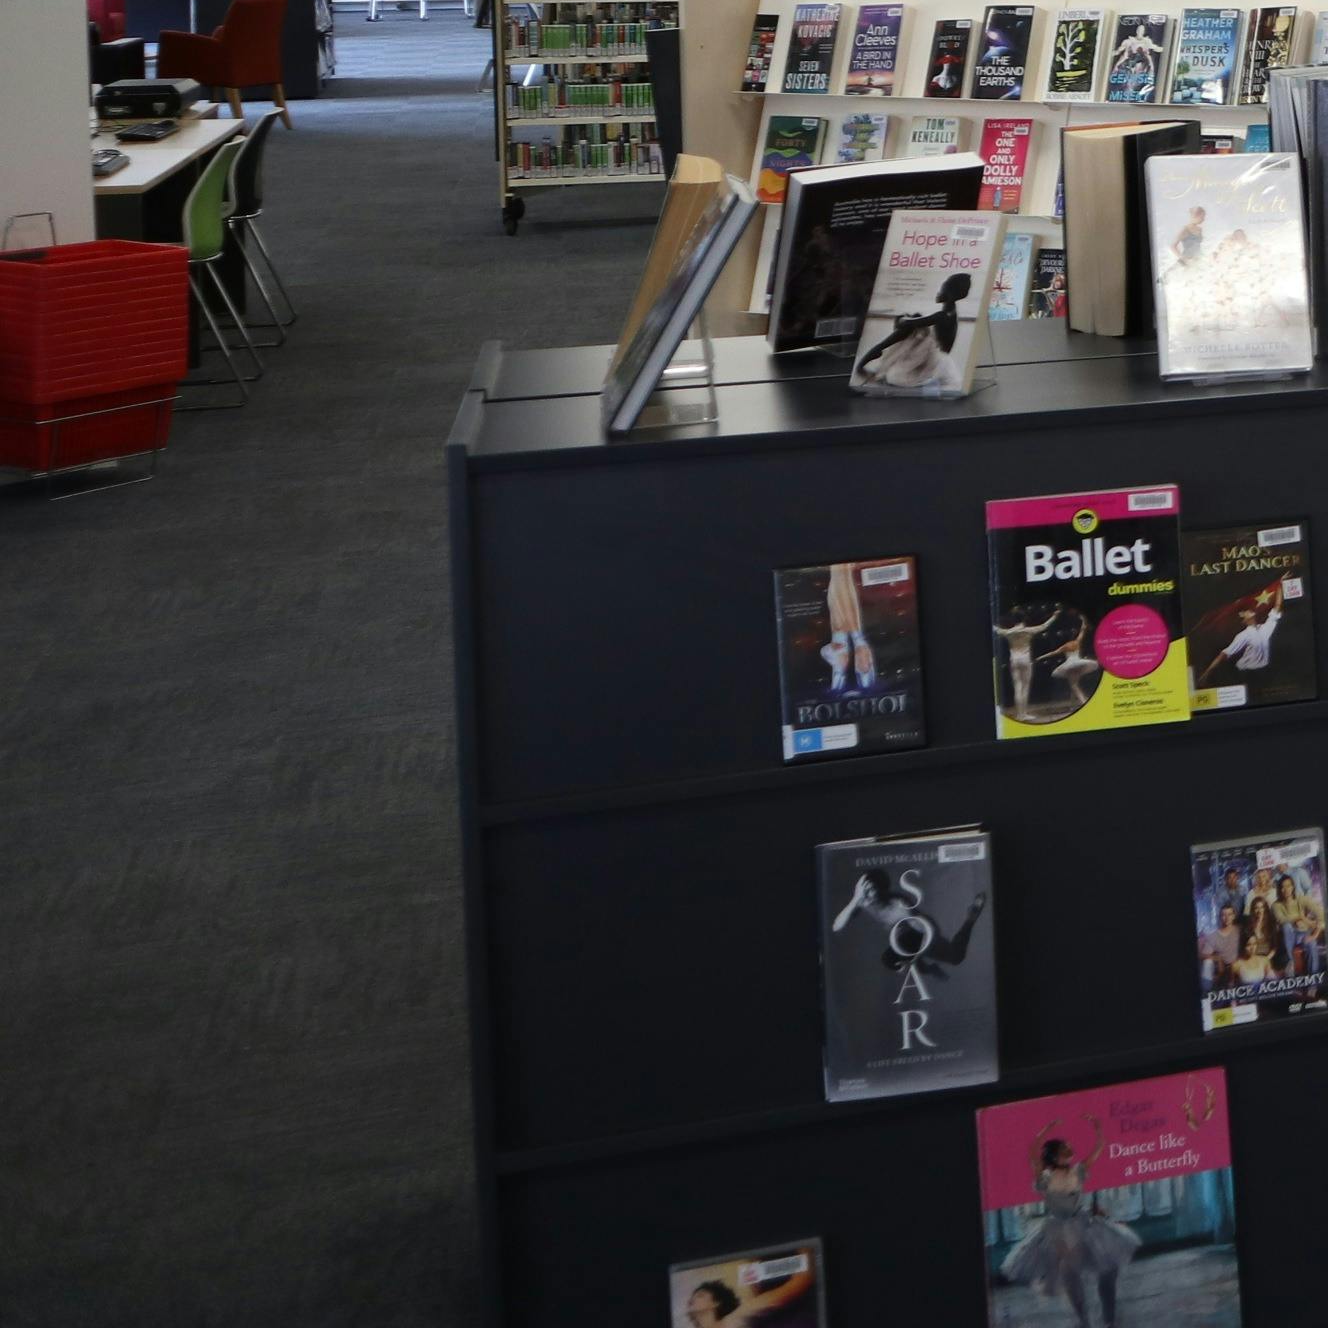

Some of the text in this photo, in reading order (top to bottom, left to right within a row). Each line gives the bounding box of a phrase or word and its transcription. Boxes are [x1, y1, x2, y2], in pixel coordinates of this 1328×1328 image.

[1183, 18, 1233, 28] HEATHER
[798, 24, 832, 38] KOVACIC
[866, 24, 888, 35] Ann
[1181, 30, 1231, 40] GRAHAM
[855, 33, 896, 46] Cleeves
[856, 51, 891, 60] A BIRD IN
[1180, 45, 1229, 54] WHISPERS
[799, 61, 819, 72] SEVEN
[852, 60, 892, 70] THE HAND
[991, 56, 1010, 66] THE
[1192, 56, 1225, 67] DUSK
[976, 66, 1024, 76] THOUSAND
[786, 74, 826, 90] SISTERS
[980, 77, 1015, 86] EARTHS
[925, 118, 945, 130] TOM
[911, 130, 956, 144] KENEALLY
[1001, 130, 1013, 139] THE
[996, 138, 1015, 147] ONE
[989, 155, 1016, 165] ONLY
[984, 165, 1018, 176] DOLLY
[902, 230, 945, 249] Hope
[889, 252, 981, 269] Ballet Shoe
[1025, 537, 1152, 582] Ballet
[1191, 555, 1299, 576] LAST DANCER
[1108, 579, 1174, 596] dummies
[799, 694, 906, 722] BOLSHOI
[855, 855, 893, 867] DAVID
[889, 869, 937, 1050] SOAR
[1208, 972, 1325, 1003] DANCE ACADEMY
[1109, 1134, 1186, 1159] Dance like
[1125, 1150, 1200, 1176] a Butterfly
